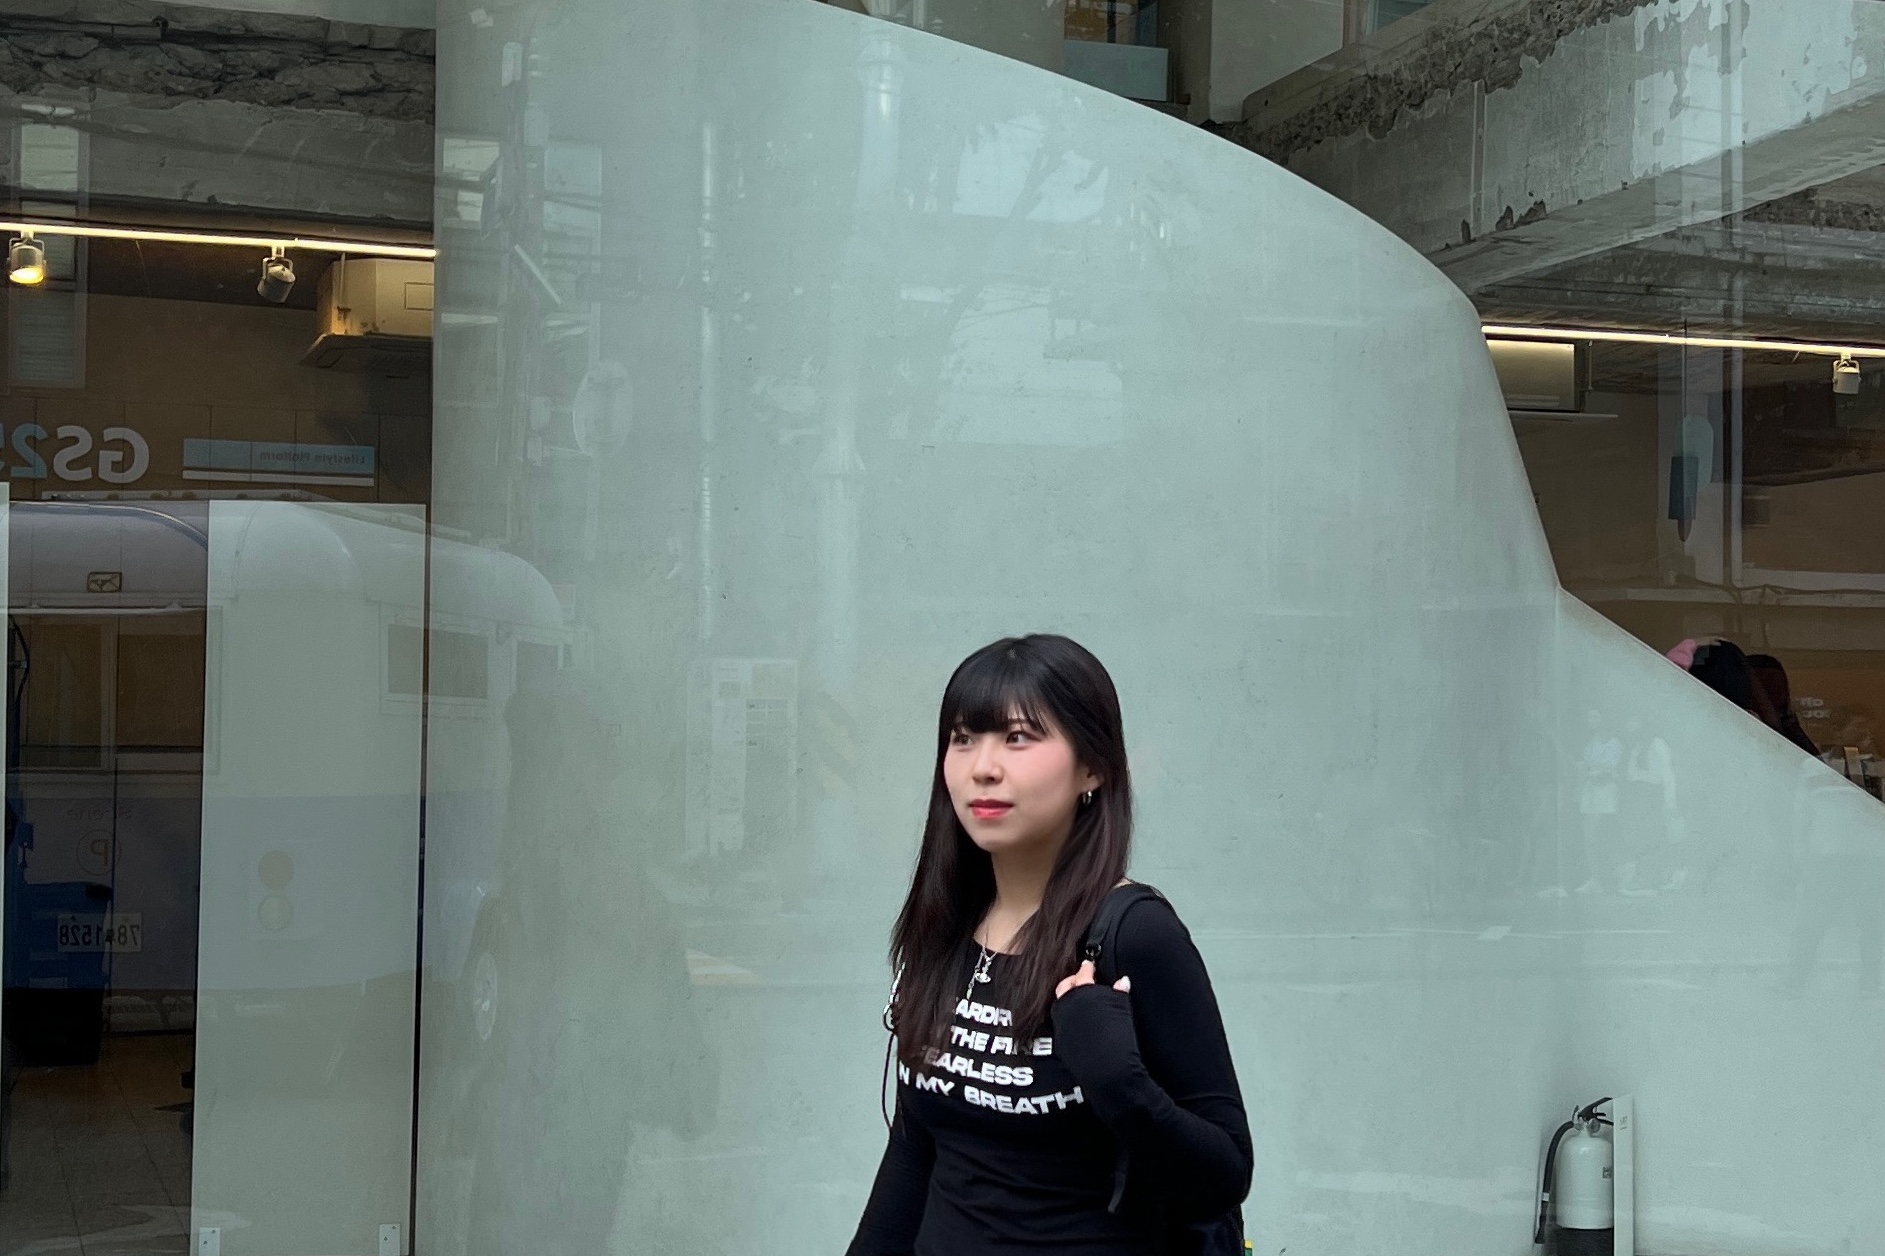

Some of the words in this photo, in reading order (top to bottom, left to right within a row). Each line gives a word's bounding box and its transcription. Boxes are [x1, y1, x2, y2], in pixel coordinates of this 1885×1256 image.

[955, 998, 1013, 1027] ARDR
[950, 1025, 990, 1052] THE
[921, 1045, 1034, 1086] EARLESS
[899, 1060, 910, 1086] N
[915, 1072, 955, 1096] MY
[964, 1085, 1084, 1114] BREATH
